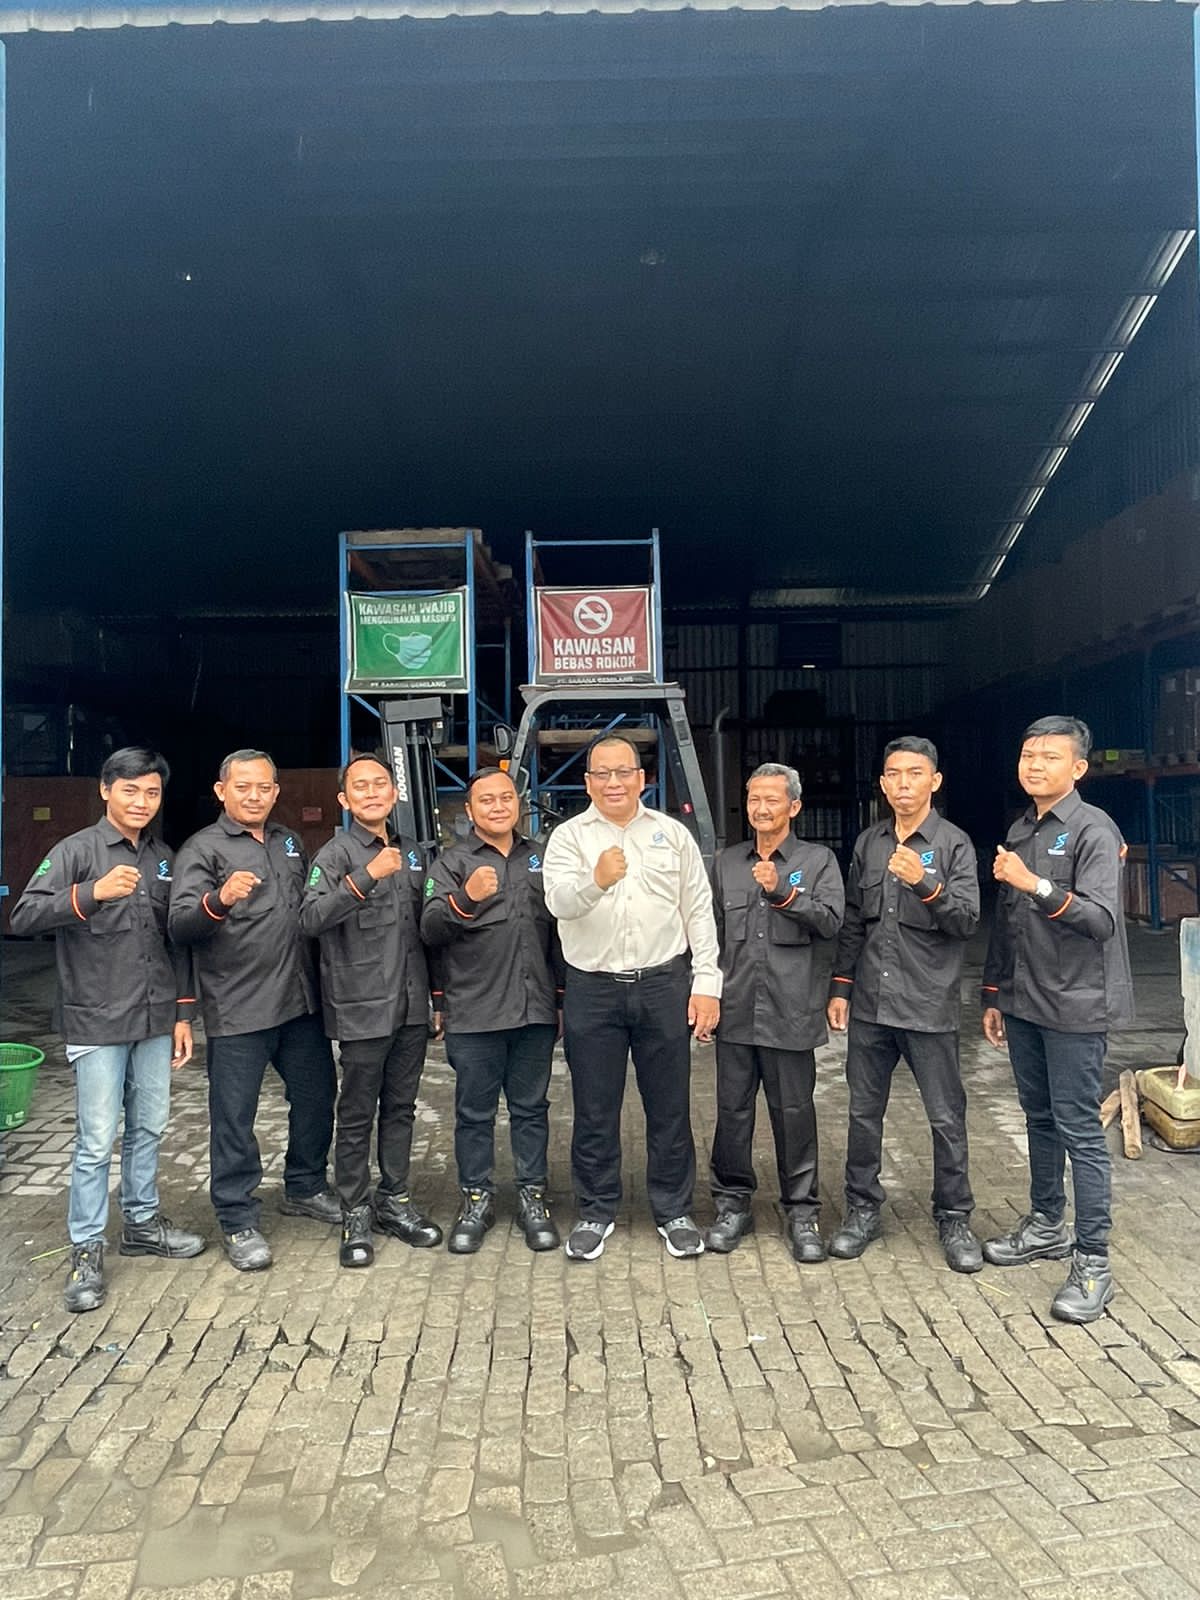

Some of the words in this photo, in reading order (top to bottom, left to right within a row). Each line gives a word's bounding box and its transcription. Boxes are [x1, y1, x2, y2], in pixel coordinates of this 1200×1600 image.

[360, 604, 416, 615] KAWASAN
[420, 601, 456, 613] WAJIB
[553, 637, 635, 655] KAWASAN
[554, 657, 593, 669] BEBAS
[596, 656, 636, 669] ROKOK
[393, 746, 408, 801] DOOSAN
